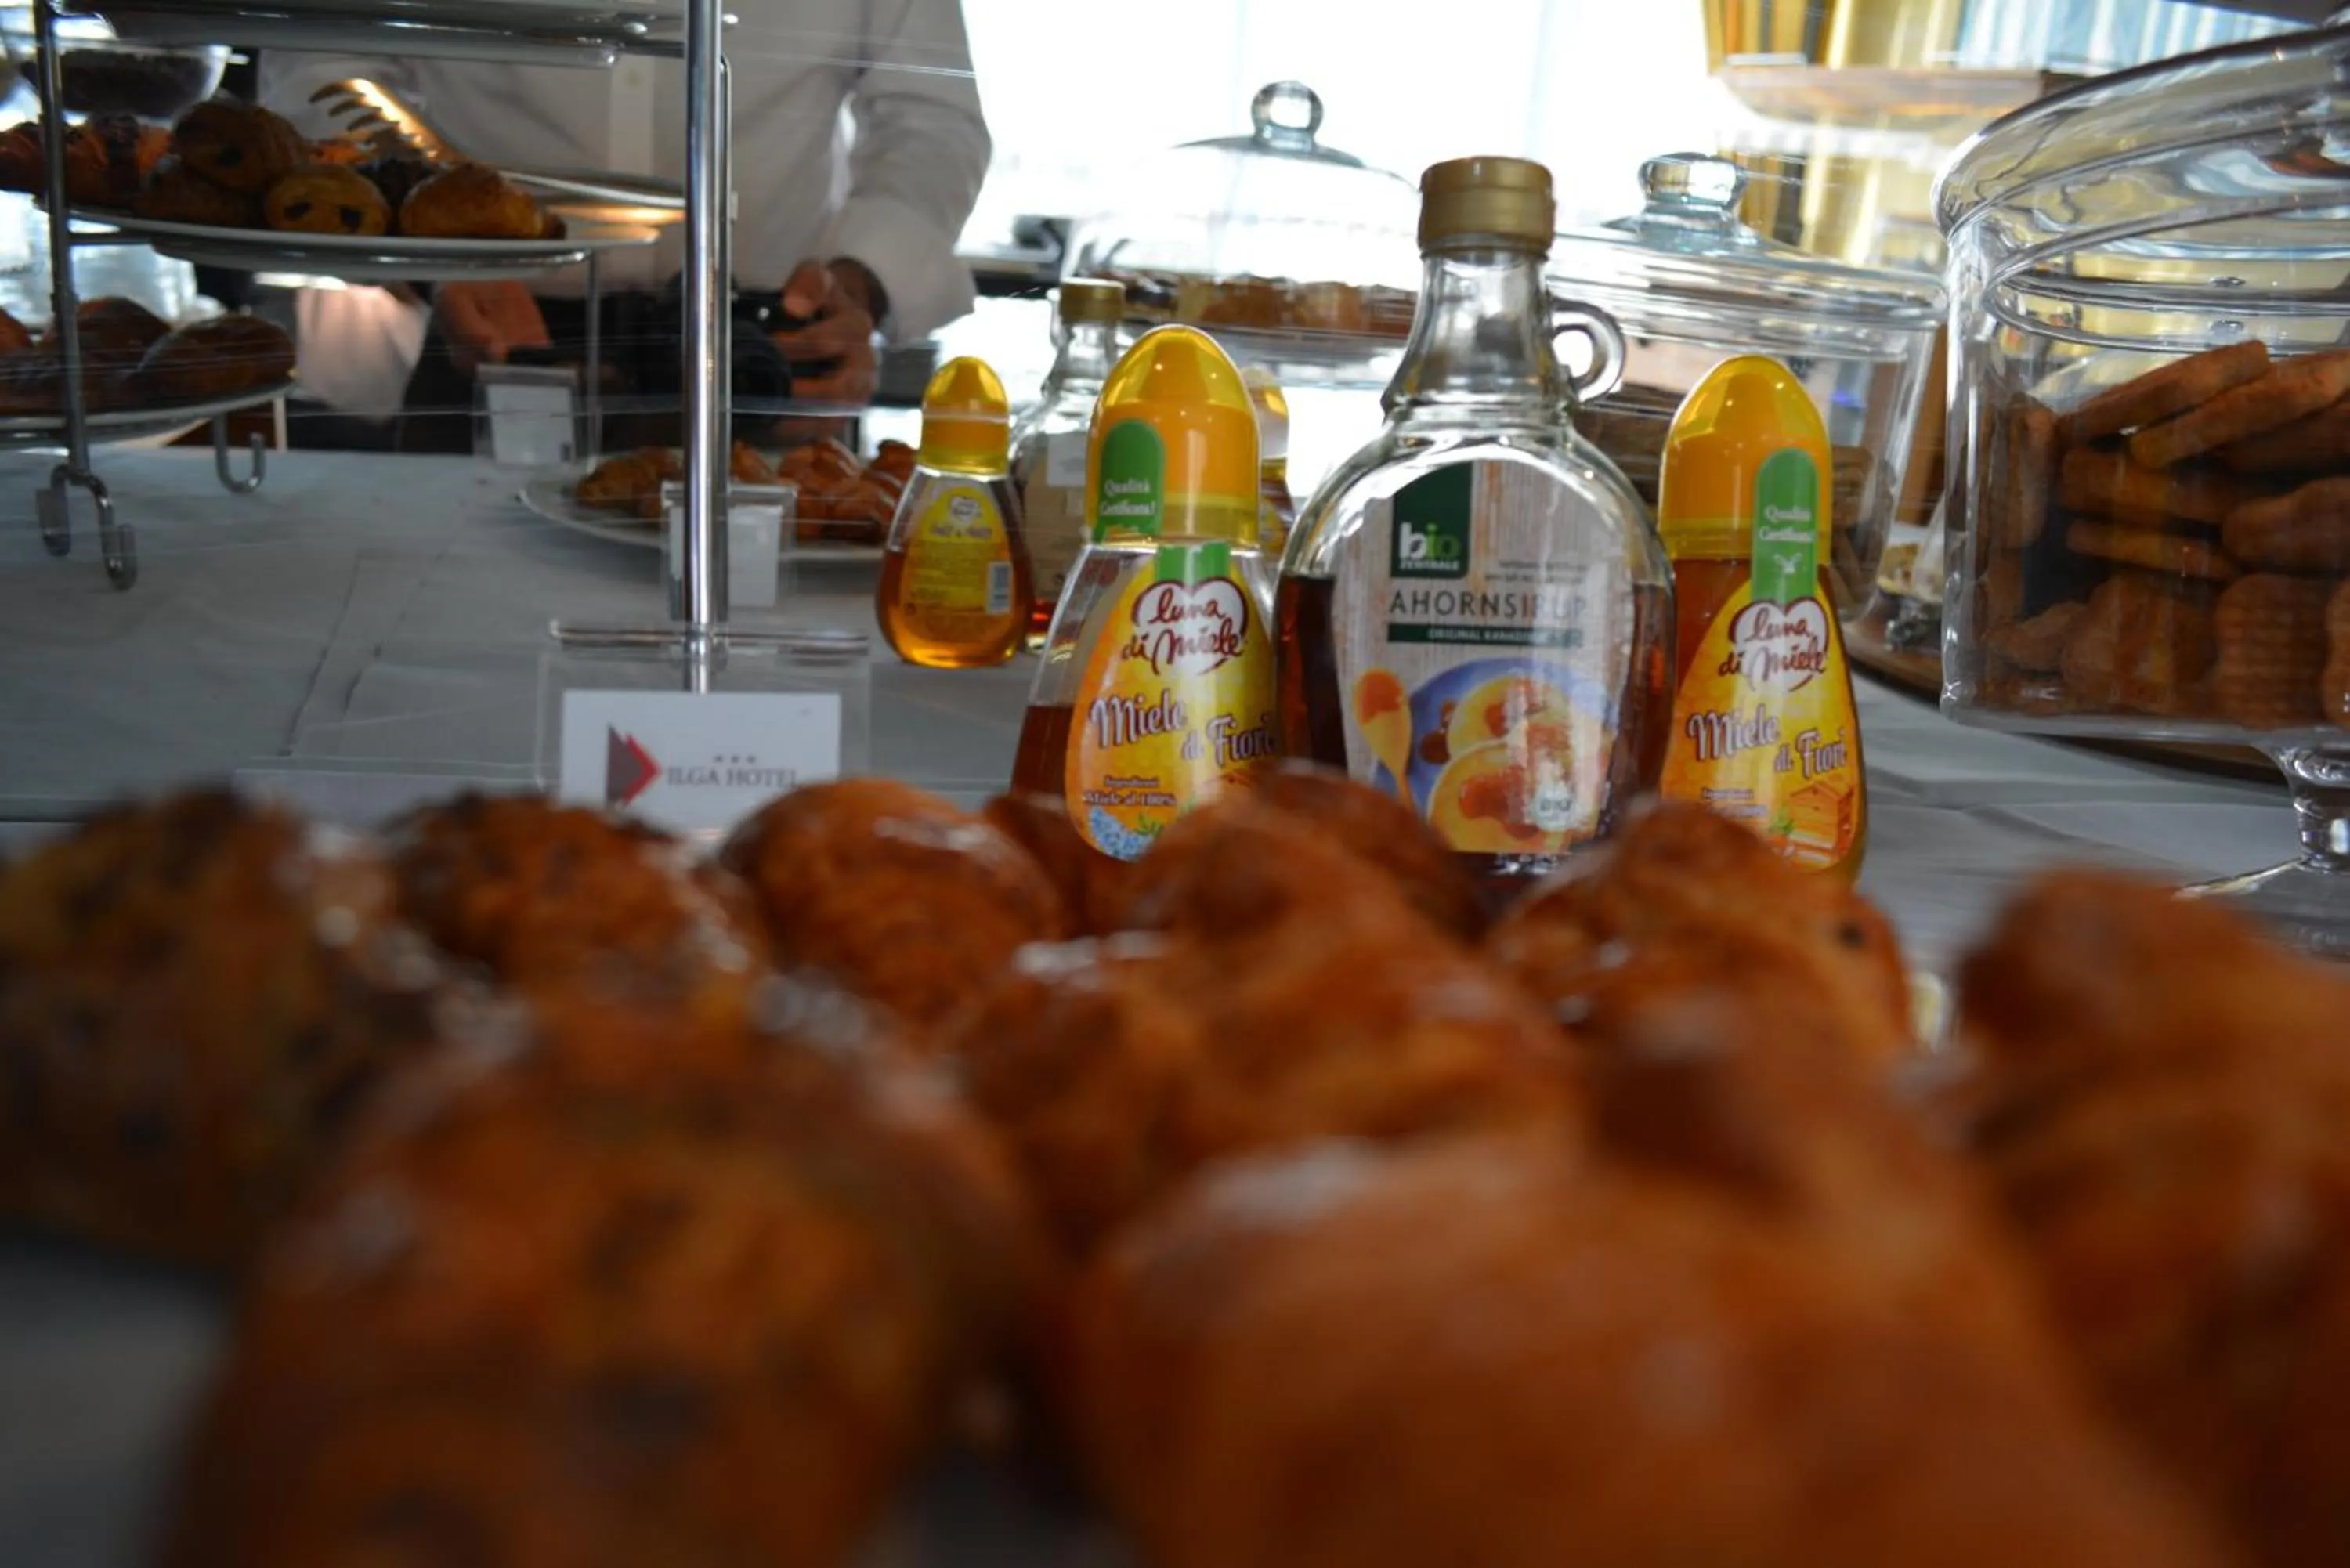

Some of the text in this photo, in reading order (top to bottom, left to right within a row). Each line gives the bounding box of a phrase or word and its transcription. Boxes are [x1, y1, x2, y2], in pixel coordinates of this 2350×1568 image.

[1399, 521, 1462, 561] bio
[1089, 688, 1188, 749] Miele
[1687, 703, 1780, 762] Miele
[1795, 725, 1847, 779] Fiori
